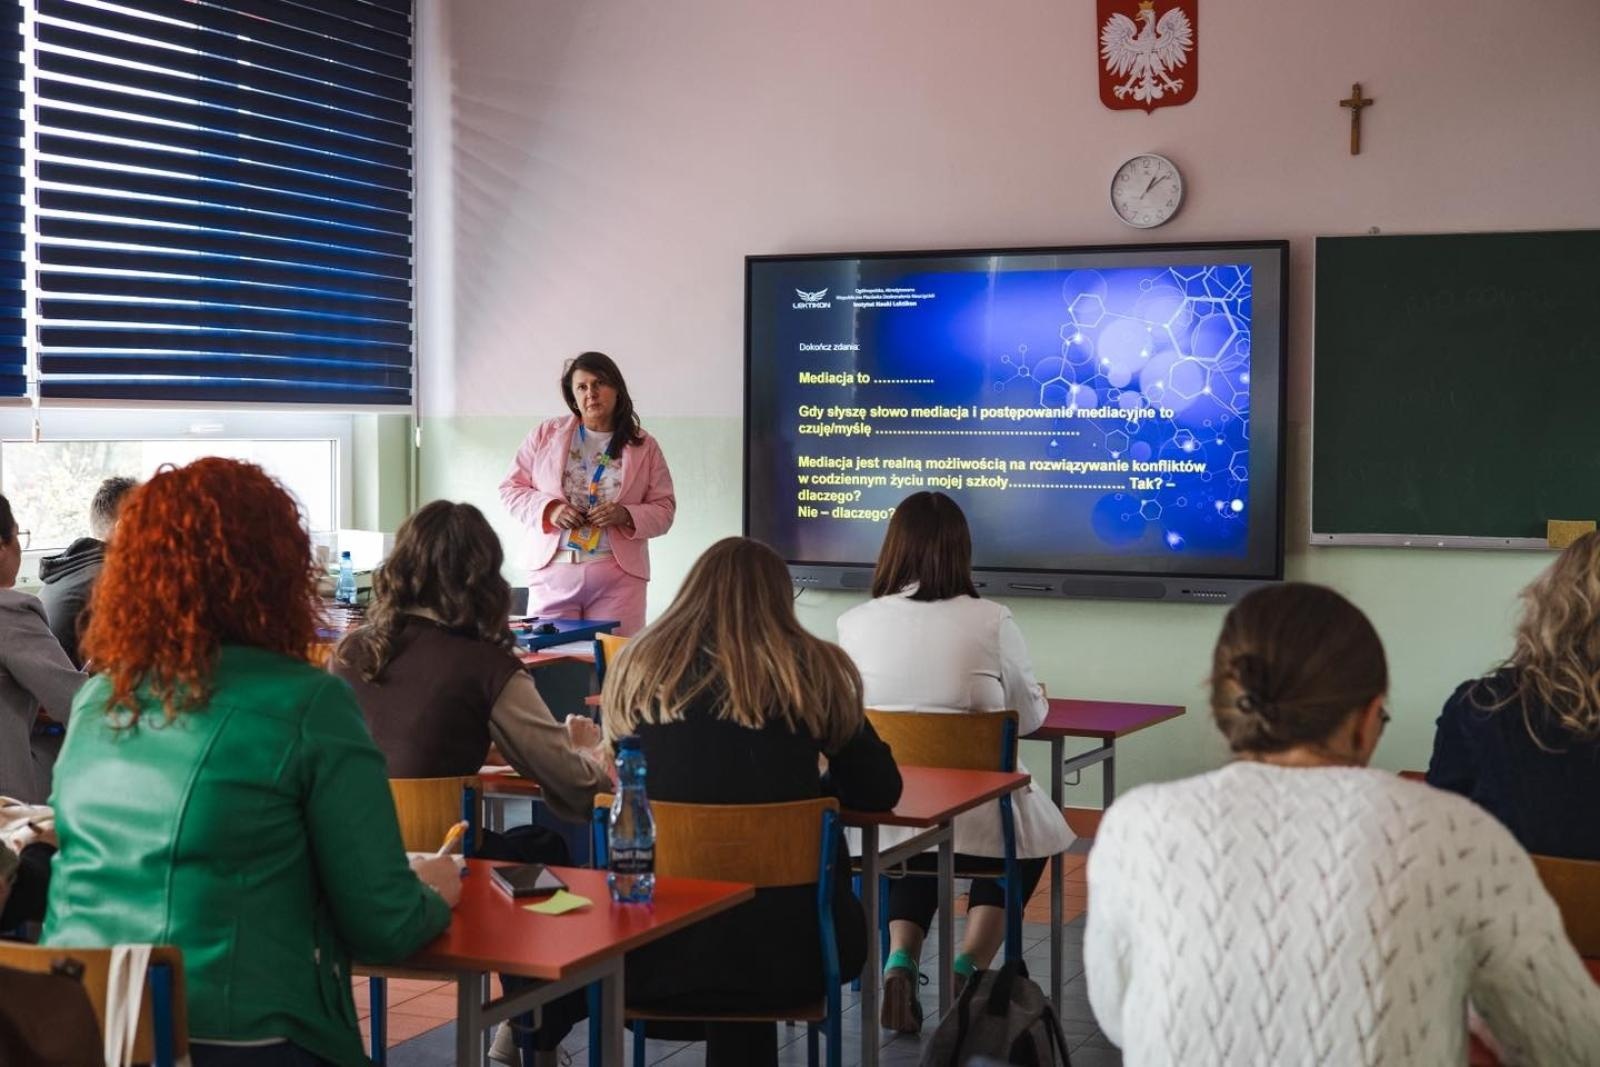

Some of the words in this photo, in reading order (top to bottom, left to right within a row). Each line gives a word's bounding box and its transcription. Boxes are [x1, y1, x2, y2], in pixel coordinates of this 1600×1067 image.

[792, 301, 831, 309] LEKTIKON
[799, 342, 831, 352] Dokończ
[799, 372, 854, 387] Mediacja
[857, 373, 870, 384] to
[798, 405, 824, 420] Gdy
[826, 405, 866, 420] słyszę
[869, 406, 908, 418] słowo
[911, 406, 969, 420] mediacja
[972, 406, 976, 417] i
[980, 406, 1073, 421] postępowanie
[1077, 406, 1156, 422] mediacyjne
[1159, 407, 1173, 418] to
[798, 422, 872, 437] czuję/myślę
[798, 456, 853, 471] Mediacja
[854, 457, 880, 471] jest
[883, 457, 922, 471] realną
[925, 456, 1006, 472] możliwością
[1009, 461, 1025, 471] na
[1029, 459, 1129, 474] rozwiązywanie
[1132, 459, 1206, 473] konfliktów
[798, 475, 808, 484] w
[811, 474, 887, 488] codziennym
[889, 474, 924, 488] życiu
[927, 474, 962, 489] mojej
[1129, 477, 1162, 490] Tak?
[798, 490, 862, 504] dlaczego?
[798, 506, 818, 518] Nie
[831, 507, 895, 521] dlaczego?
